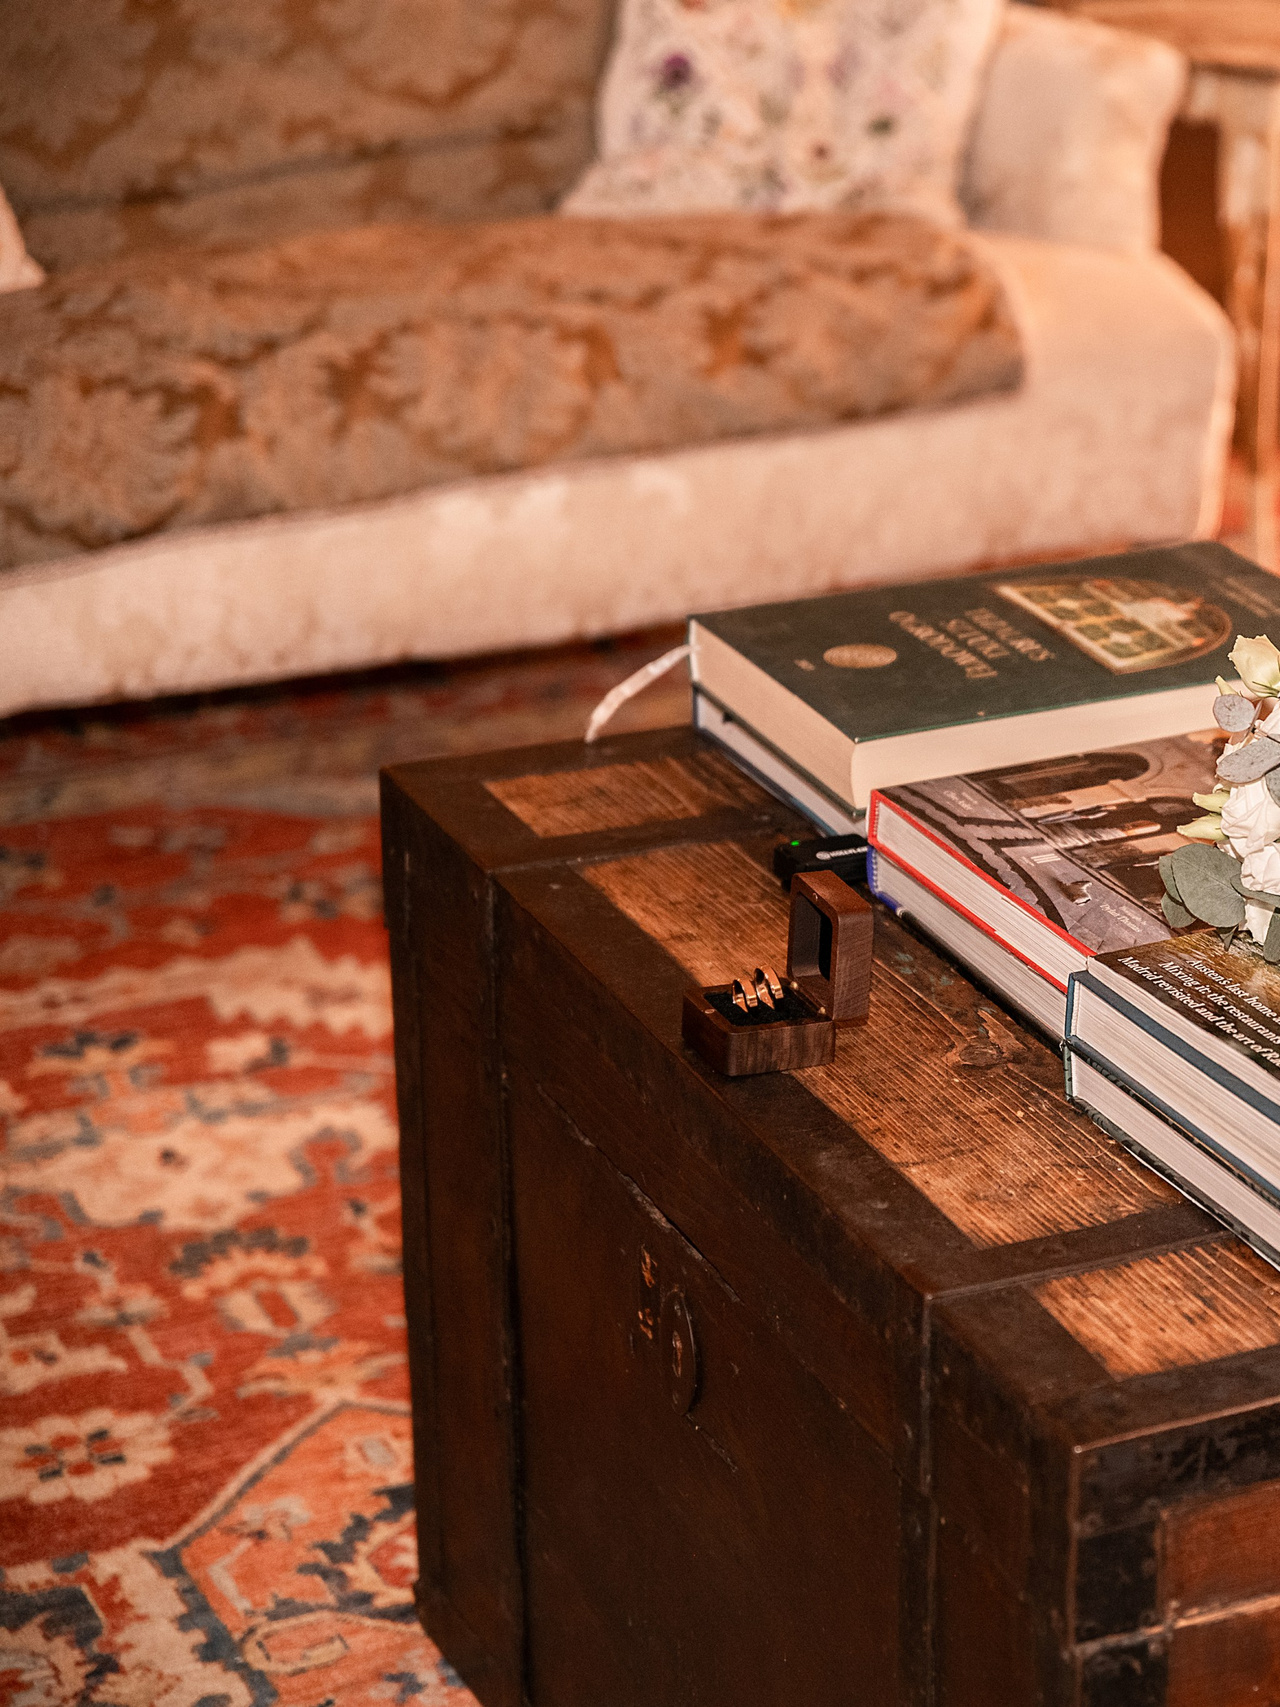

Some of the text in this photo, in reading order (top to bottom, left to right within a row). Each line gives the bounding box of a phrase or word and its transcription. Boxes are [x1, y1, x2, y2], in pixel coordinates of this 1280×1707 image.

[1117, 956, 1164, 980] Madrid
[1154, 980, 1206, 1009] revisited
[1195, 1008, 1225, 1022] and
[1216, 1020, 1238, 1034] the
[1232, 1033, 1256, 1045] art
[1250, 1042, 1274, 1056] of
[1158, 961, 1202, 987] Mixing
[1207, 992, 1228, 1006] the
[1186, 959, 1233, 985] Austen's
[1226, 983, 1250, 998] last
[1244, 995, 1278, 1018] home
